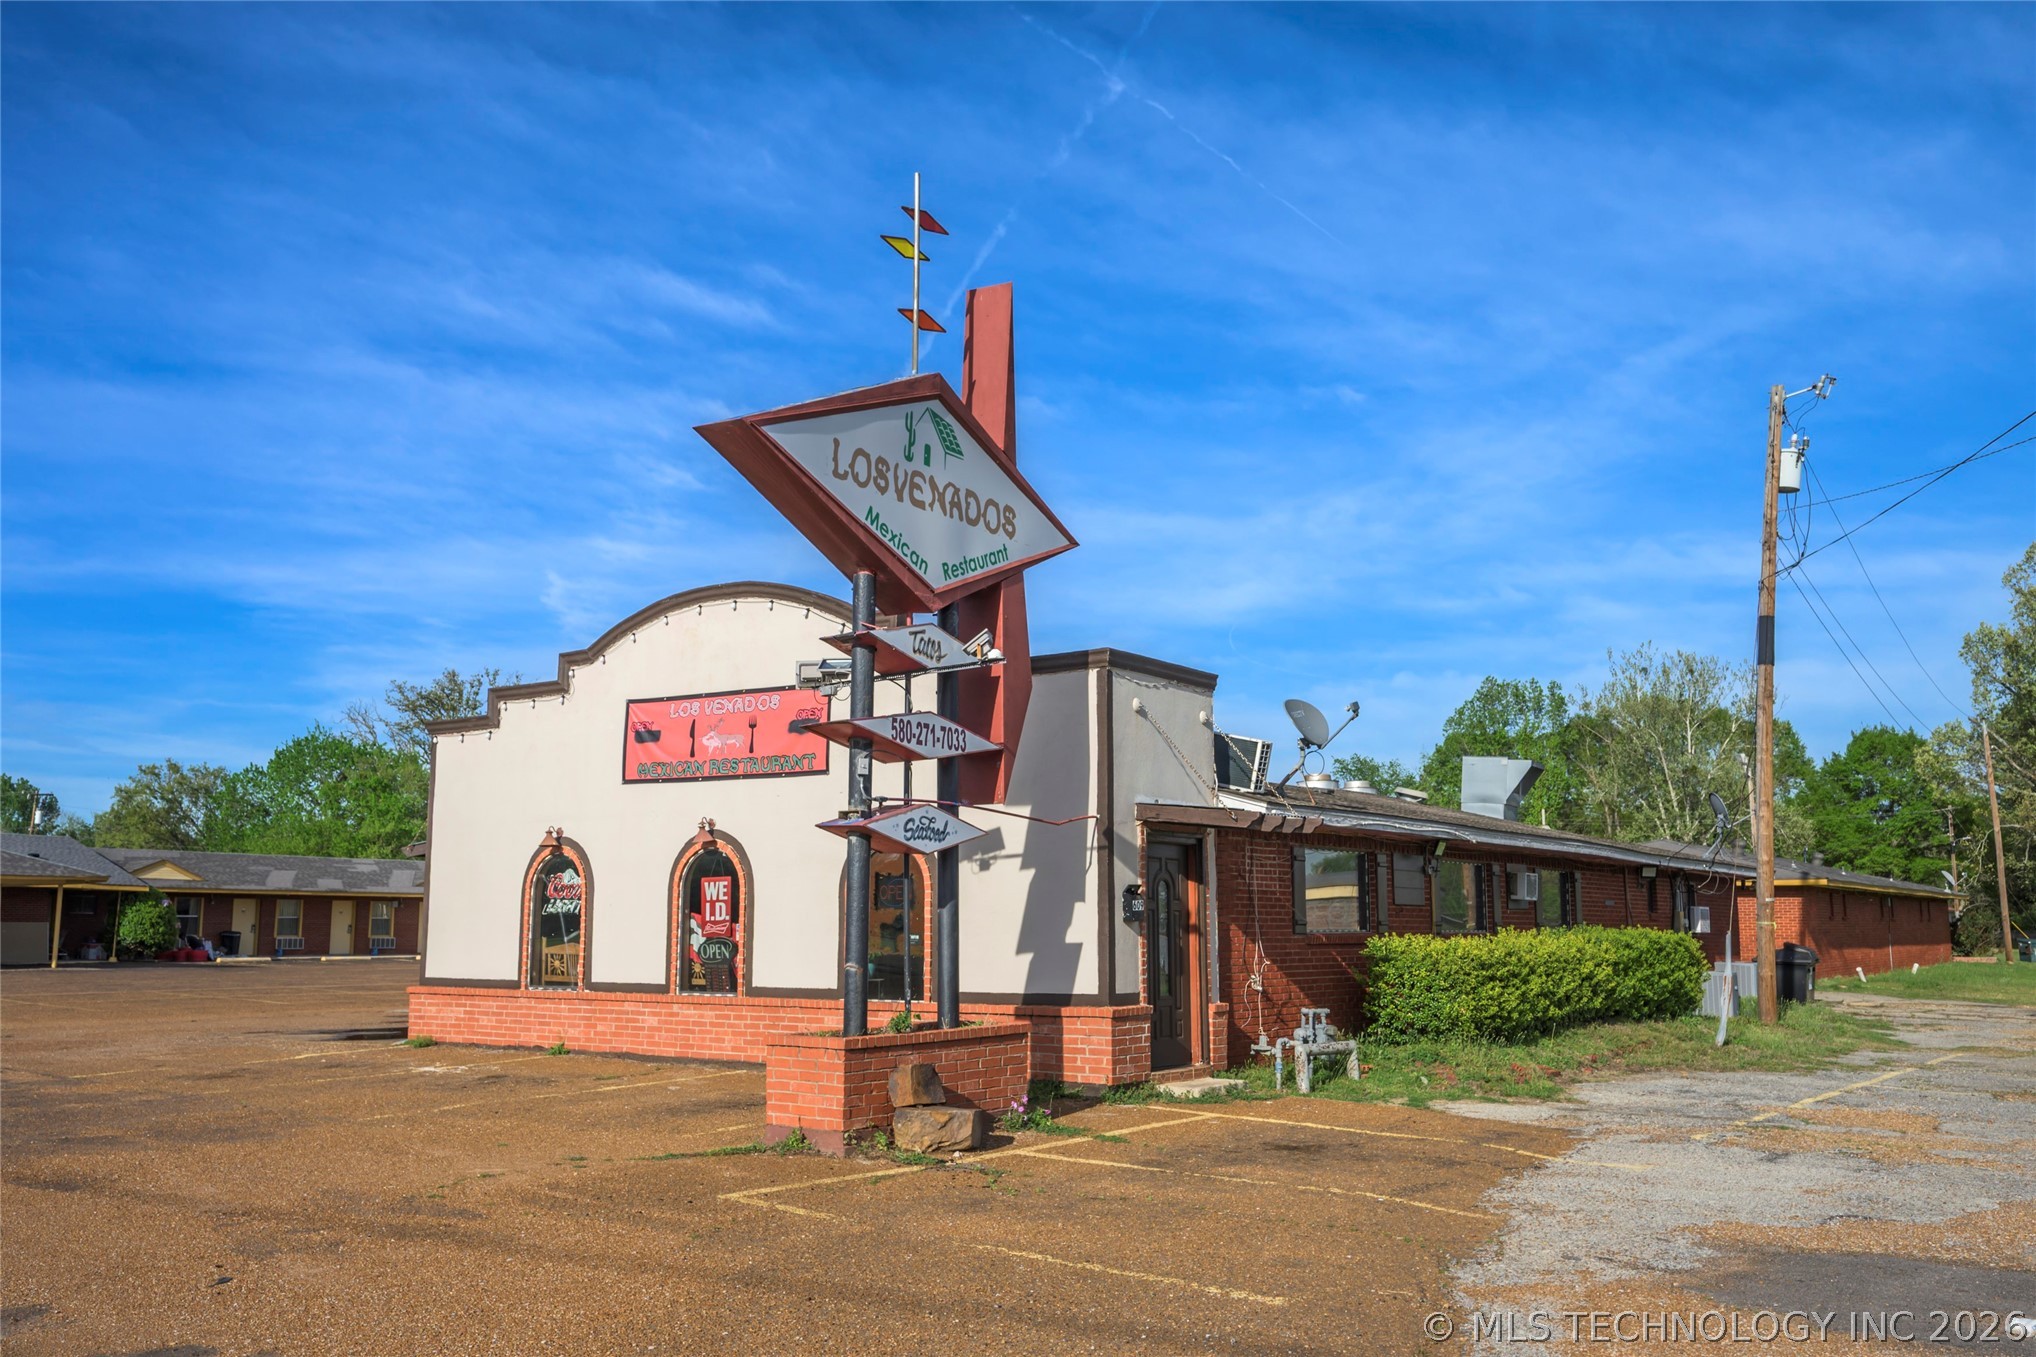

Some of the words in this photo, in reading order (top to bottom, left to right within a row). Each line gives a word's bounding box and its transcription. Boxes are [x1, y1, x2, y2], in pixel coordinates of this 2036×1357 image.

[864, 505, 929, 575] Mexican
[942, 543, 1009, 581] Restaurant
[908, 629, 949, 664] Tacos
[669, 702, 700, 719] LOS
[704, 694, 781, 716] VENADOS
[891, 717, 967, 752] 580-271-7033
[637, 759, 707, 778] MEXICAN
[708, 753, 816, 775] RESTAURANT
[903, 815, 950, 843] Seafood
[547, 873, 581, 899] Coor
[704, 881, 728, 901] WE
[705, 902, 729, 921] I.D.
[700, 943, 730, 959] OPEN
